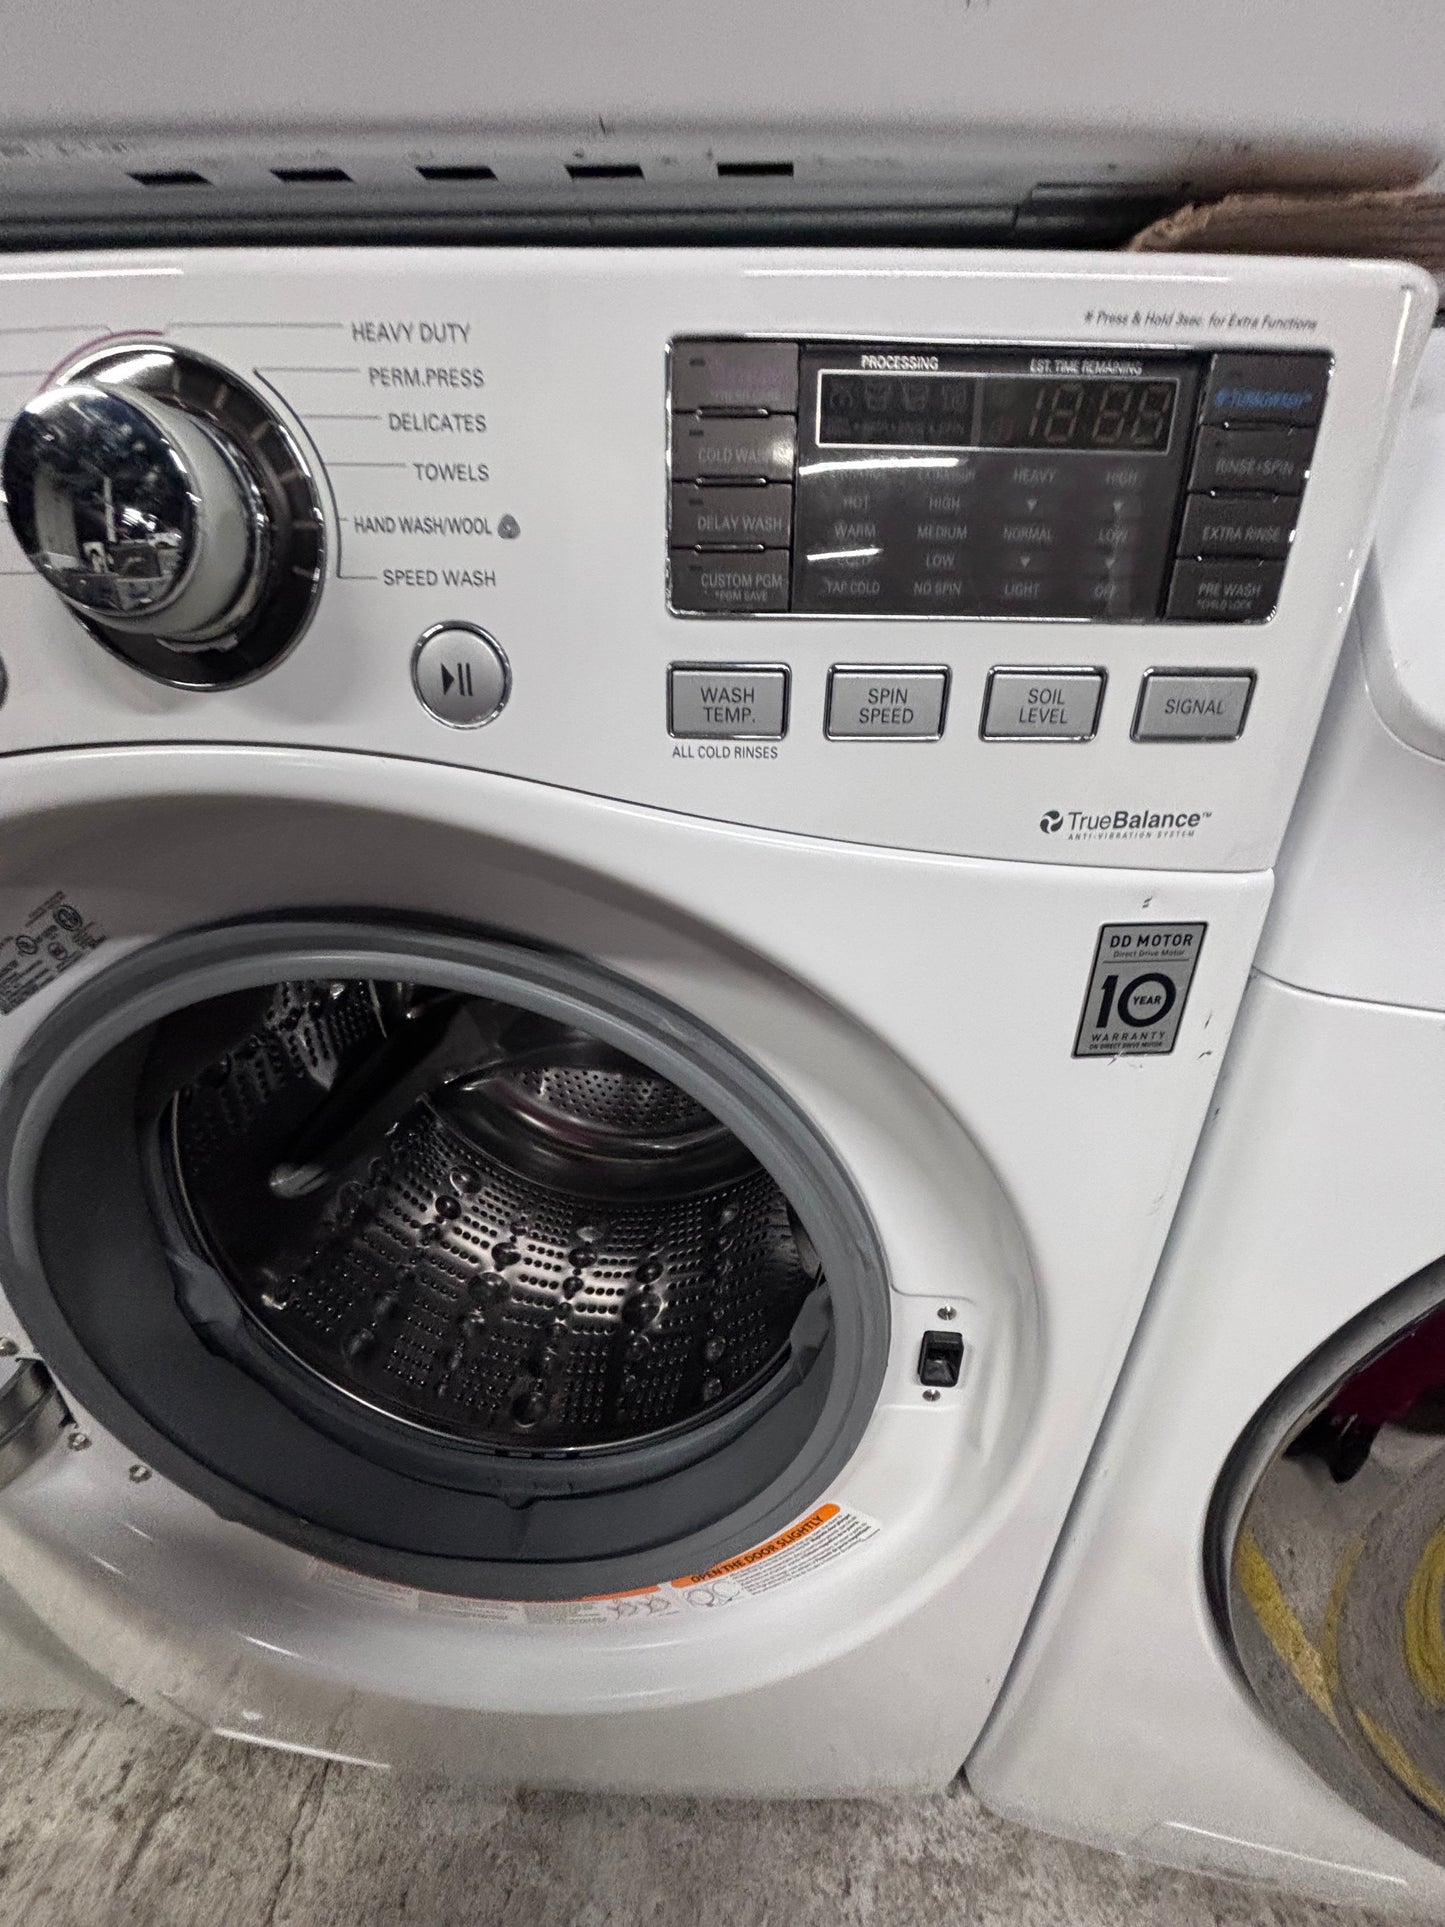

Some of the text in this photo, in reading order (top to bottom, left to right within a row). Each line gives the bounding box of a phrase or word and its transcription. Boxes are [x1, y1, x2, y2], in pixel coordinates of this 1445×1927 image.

[1145, 311, 1175, 327] Hold
[1208, 312, 1226, 327] for
[1228, 313, 1259, 329] Extra
[1262, 314, 1318, 330] Functions
[352, 322, 470, 344] HEAVY DUTY
[860, 354, 939, 370] PROCESSING
[368, 366, 485, 388] PERM.PRESS
[388, 412, 487, 433] DELICATES
[413, 462, 489, 482] TOWELS
[354, 516, 492, 536] HAND WASH/WOOL
[697, 515, 782, 533] DELAY WASH
[383, 569, 497, 587] SPEED WASH
[701, 573, 783, 590] CUSTOM PGM
[1224, 583, 1262, 599] WASH
[700, 687, 755, 704] WASH
[868, 688, 908, 704] SPIN
[1027, 688, 1065, 705] SOIL
[703, 707, 756, 724] TEMP.
[1164, 698, 1224, 716] SIGNAL
[858, 708, 914, 724] SPEED
[1018, 708, 1068, 725] LEVEL
[672, 746, 778, 760] ALL COLD RINSES
[1156, 831, 1195, 839] SYSTEM
[1109, 934, 1193, 948] DD MOTOR
[1113, 950, 1137, 958] Direct
[1139, 949, 1159, 957] Drive
[1096, 972, 1177, 1029] 10
[1133, 995, 1162, 1006] YEAR
[1091, 1031, 1166, 1042] WARRANTY
[690, 1568, 725, 1584] OPEN
[724, 1557, 746, 1575] THE
[745, 1544, 779, 1564] DOOR
[777, 1514, 825, 1549] SLIGHTLY
